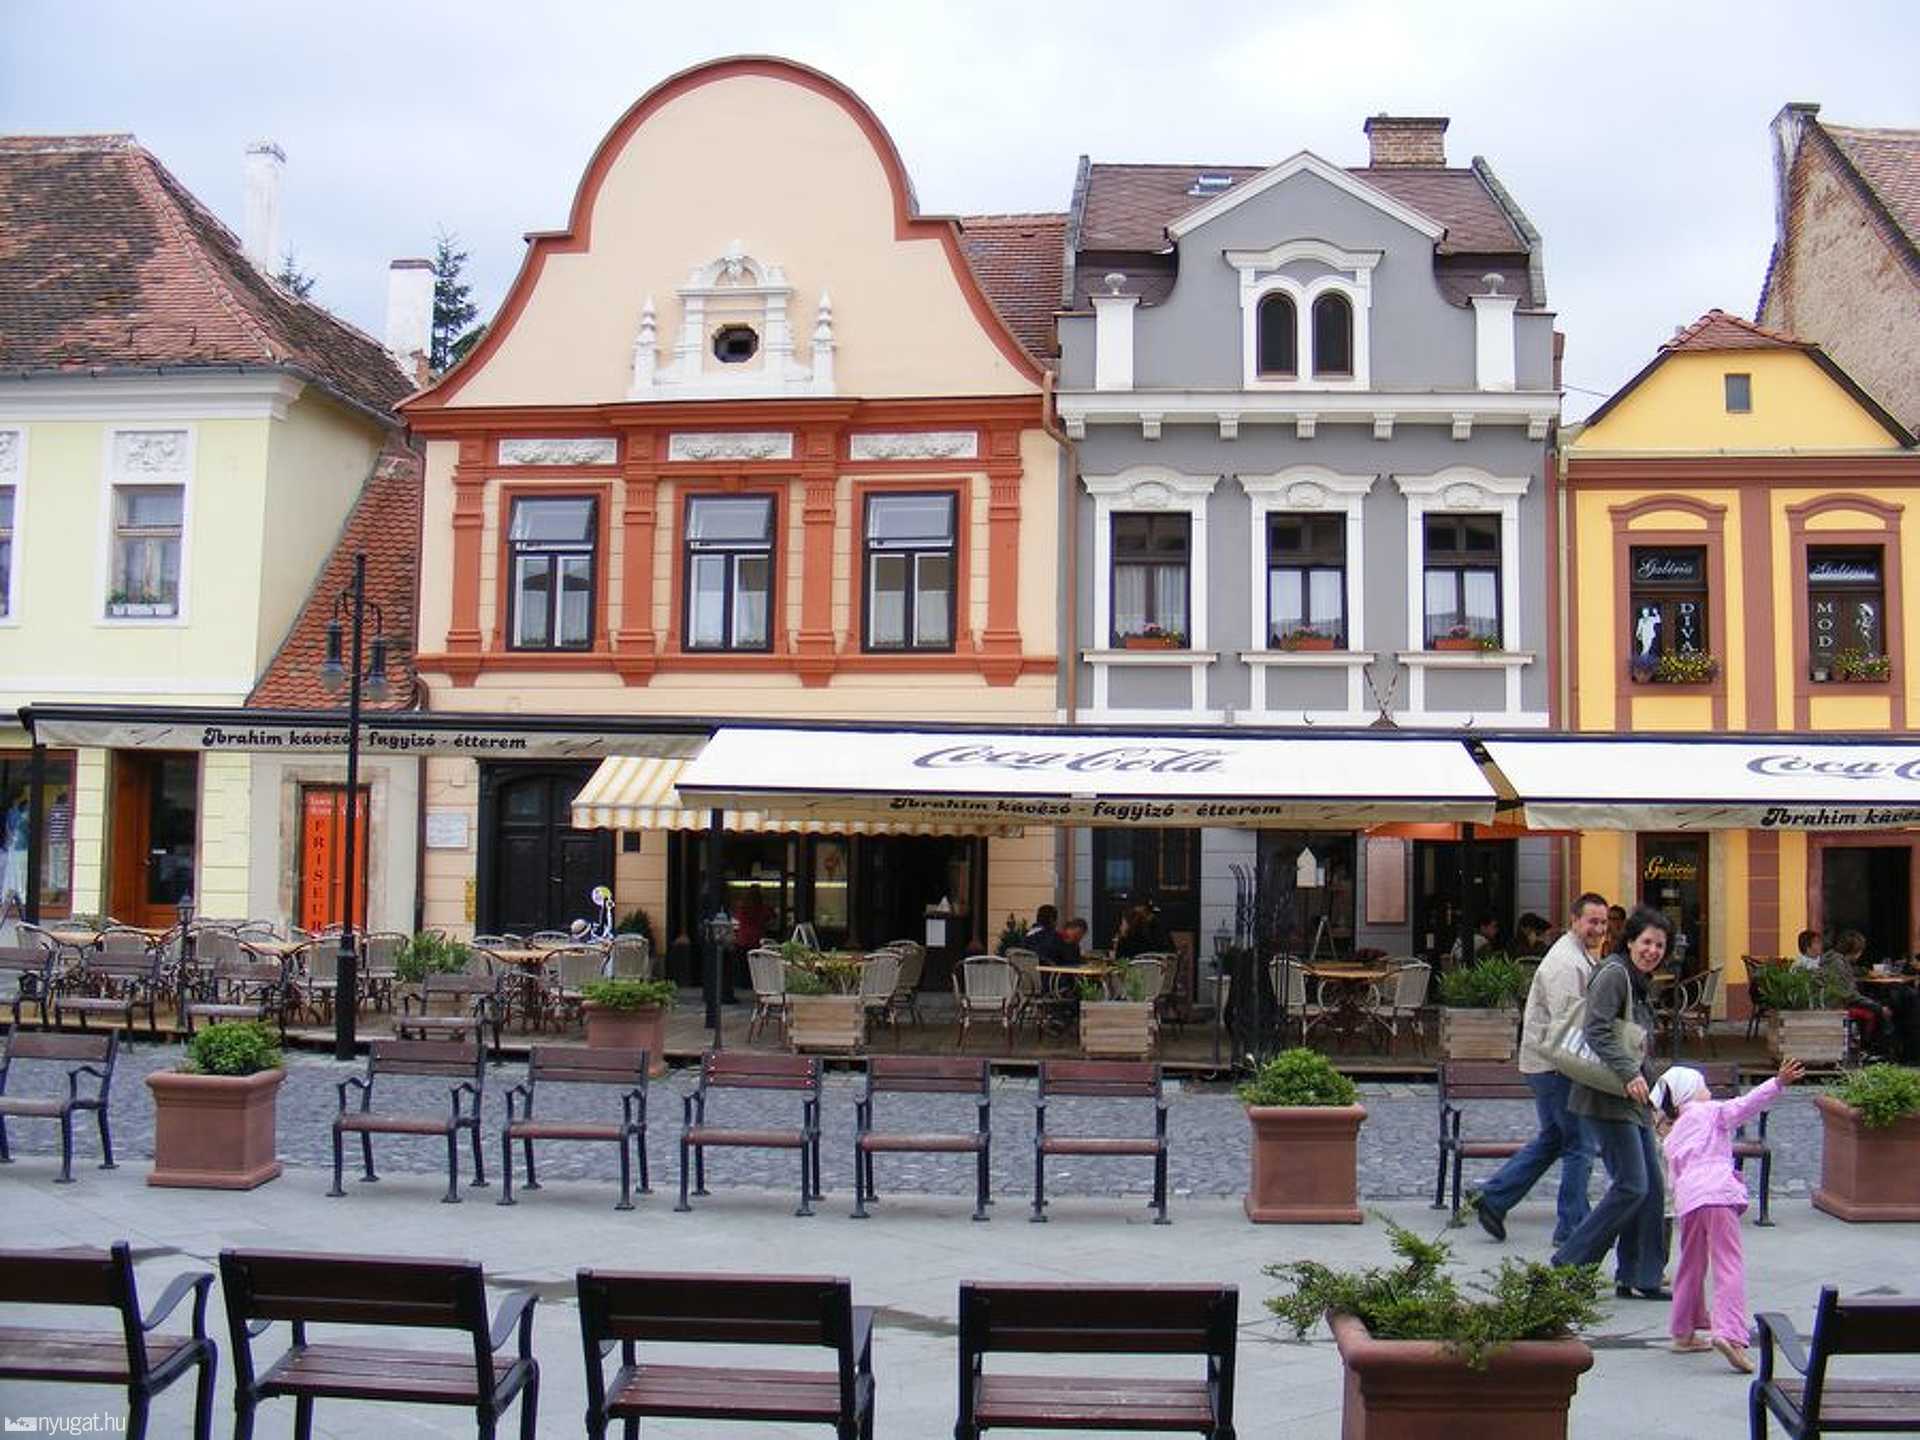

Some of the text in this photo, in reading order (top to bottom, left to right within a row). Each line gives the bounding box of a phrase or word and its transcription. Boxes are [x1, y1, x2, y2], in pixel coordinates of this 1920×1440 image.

[1680, 603, 1696, 652] DIVA
[202, 727, 283, 747] Ibrahim
[369, 732, 437, 750] fagyizó
[453, 734, 527, 749] étterem
[1746, 755, 1920, 780] Coca-C
[996, 801, 1071, 816] kávézó
[1093, 802, 1175, 821] fagyizó
[1196, 804, 1281, 817] étterem
[1761, 808, 1857, 826] Ibrahim
